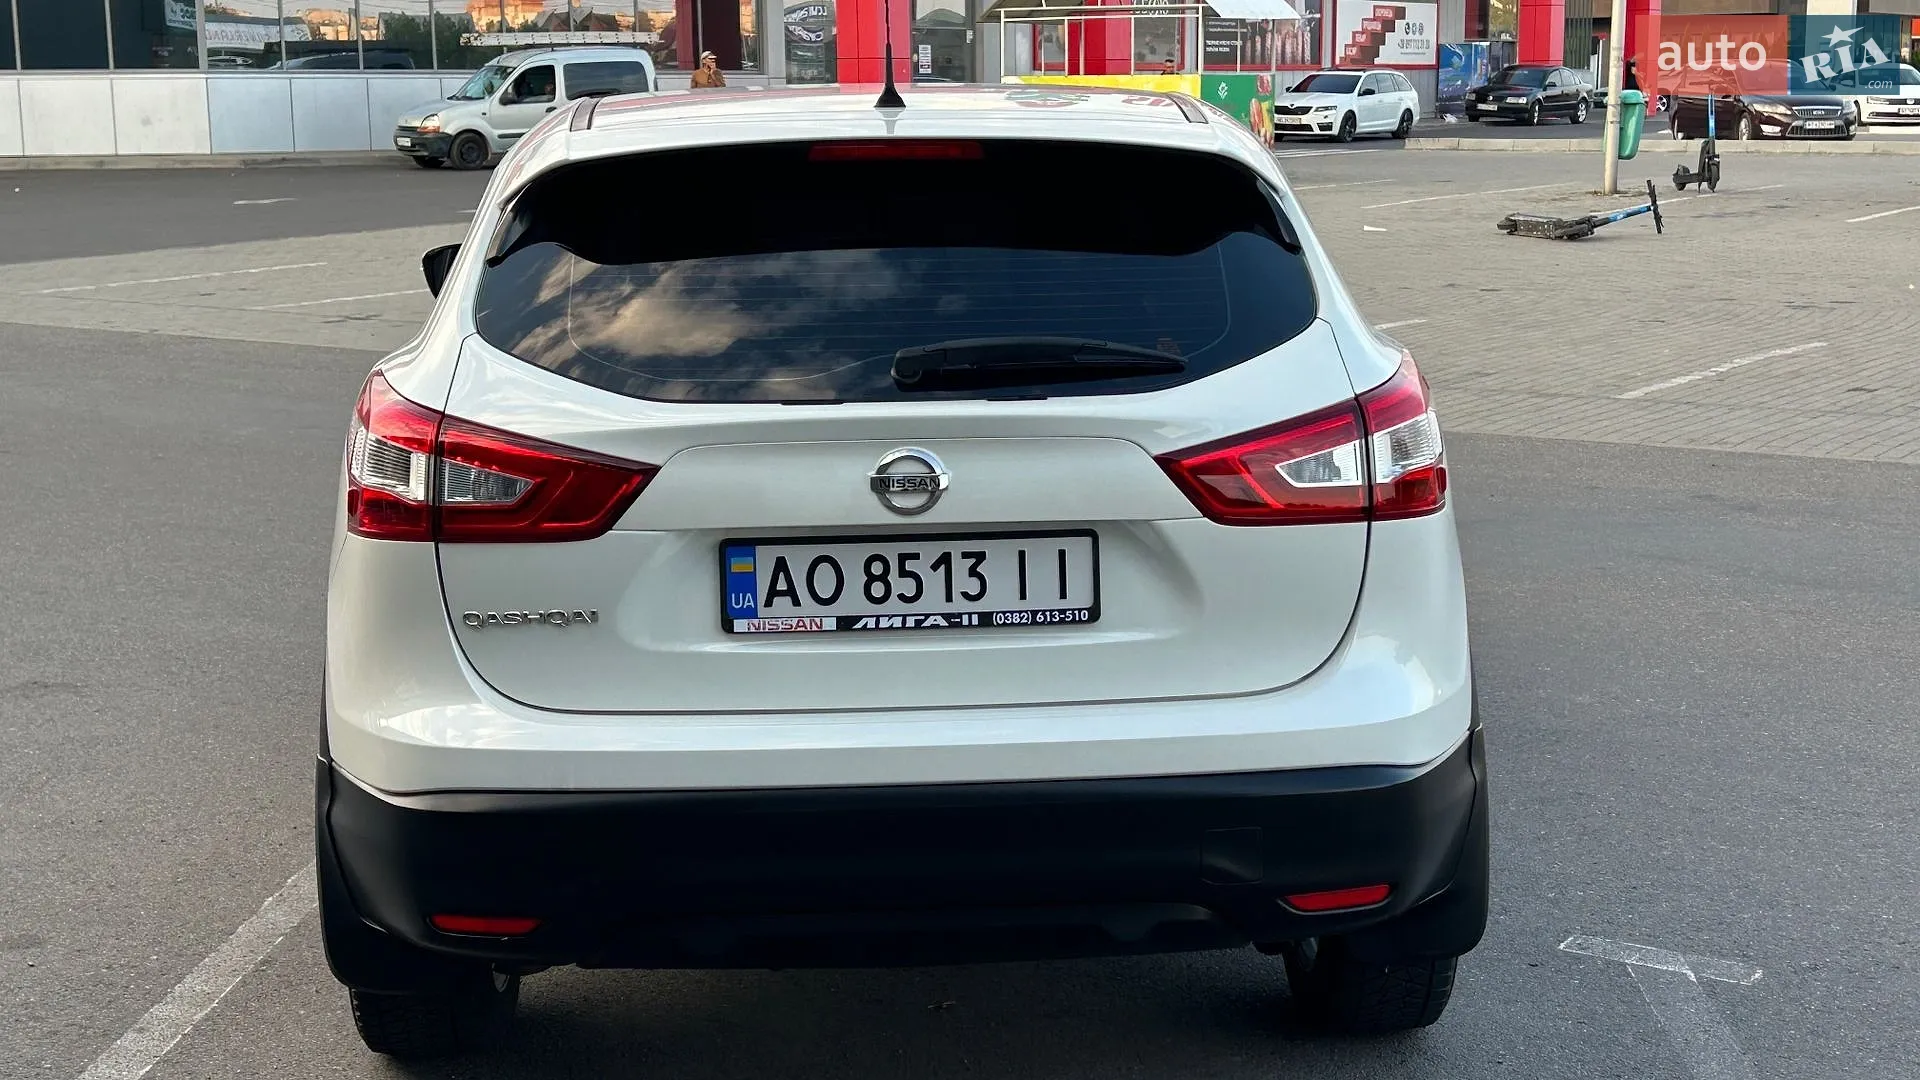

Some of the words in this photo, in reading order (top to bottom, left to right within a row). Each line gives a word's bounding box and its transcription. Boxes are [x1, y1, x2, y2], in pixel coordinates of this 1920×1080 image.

[879, 477, 940, 489] NISSAN
[763, 554, 846, 608] AO
[863, 550, 988, 605] 8513
[731, 593, 755, 609] UA
[462, 609, 599, 629] QASHQAI
[747, 618, 824, 631] NISSAN
[993, 612, 1032, 625] (0382)
[1036, 610, 1089, 623] 613-510
